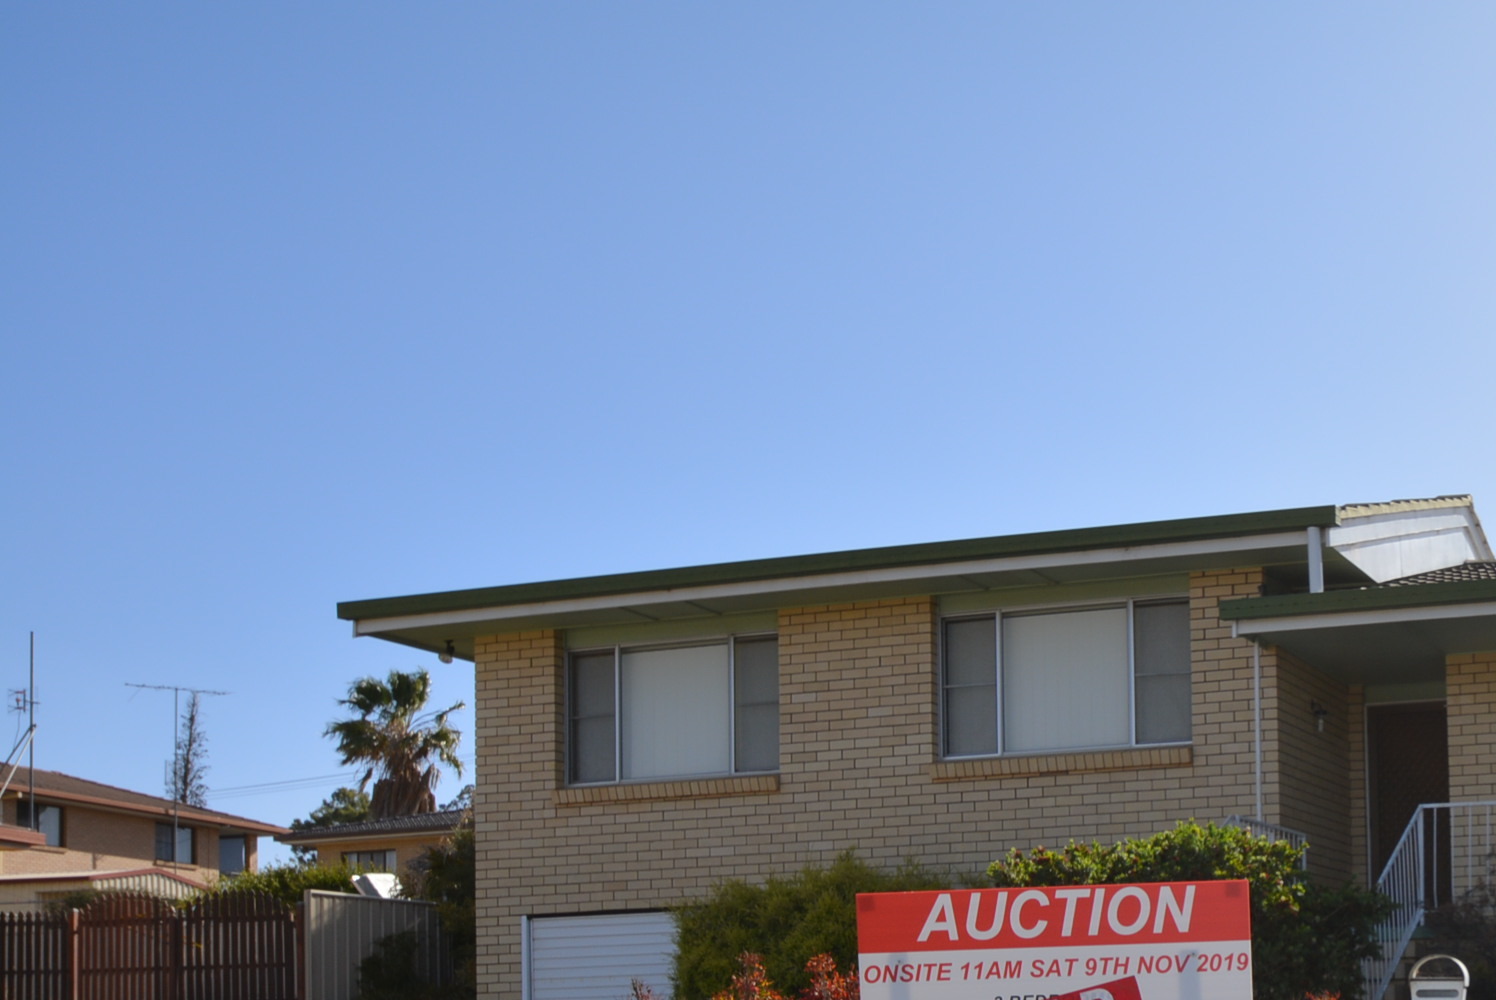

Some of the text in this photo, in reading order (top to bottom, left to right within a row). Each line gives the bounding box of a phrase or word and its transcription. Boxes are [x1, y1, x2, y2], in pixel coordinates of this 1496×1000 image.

[917, 885, 1196, 942] AUCTION
[864, 952, 1249, 984] ONSITE 11AM SAT 9TH NOV 2019
